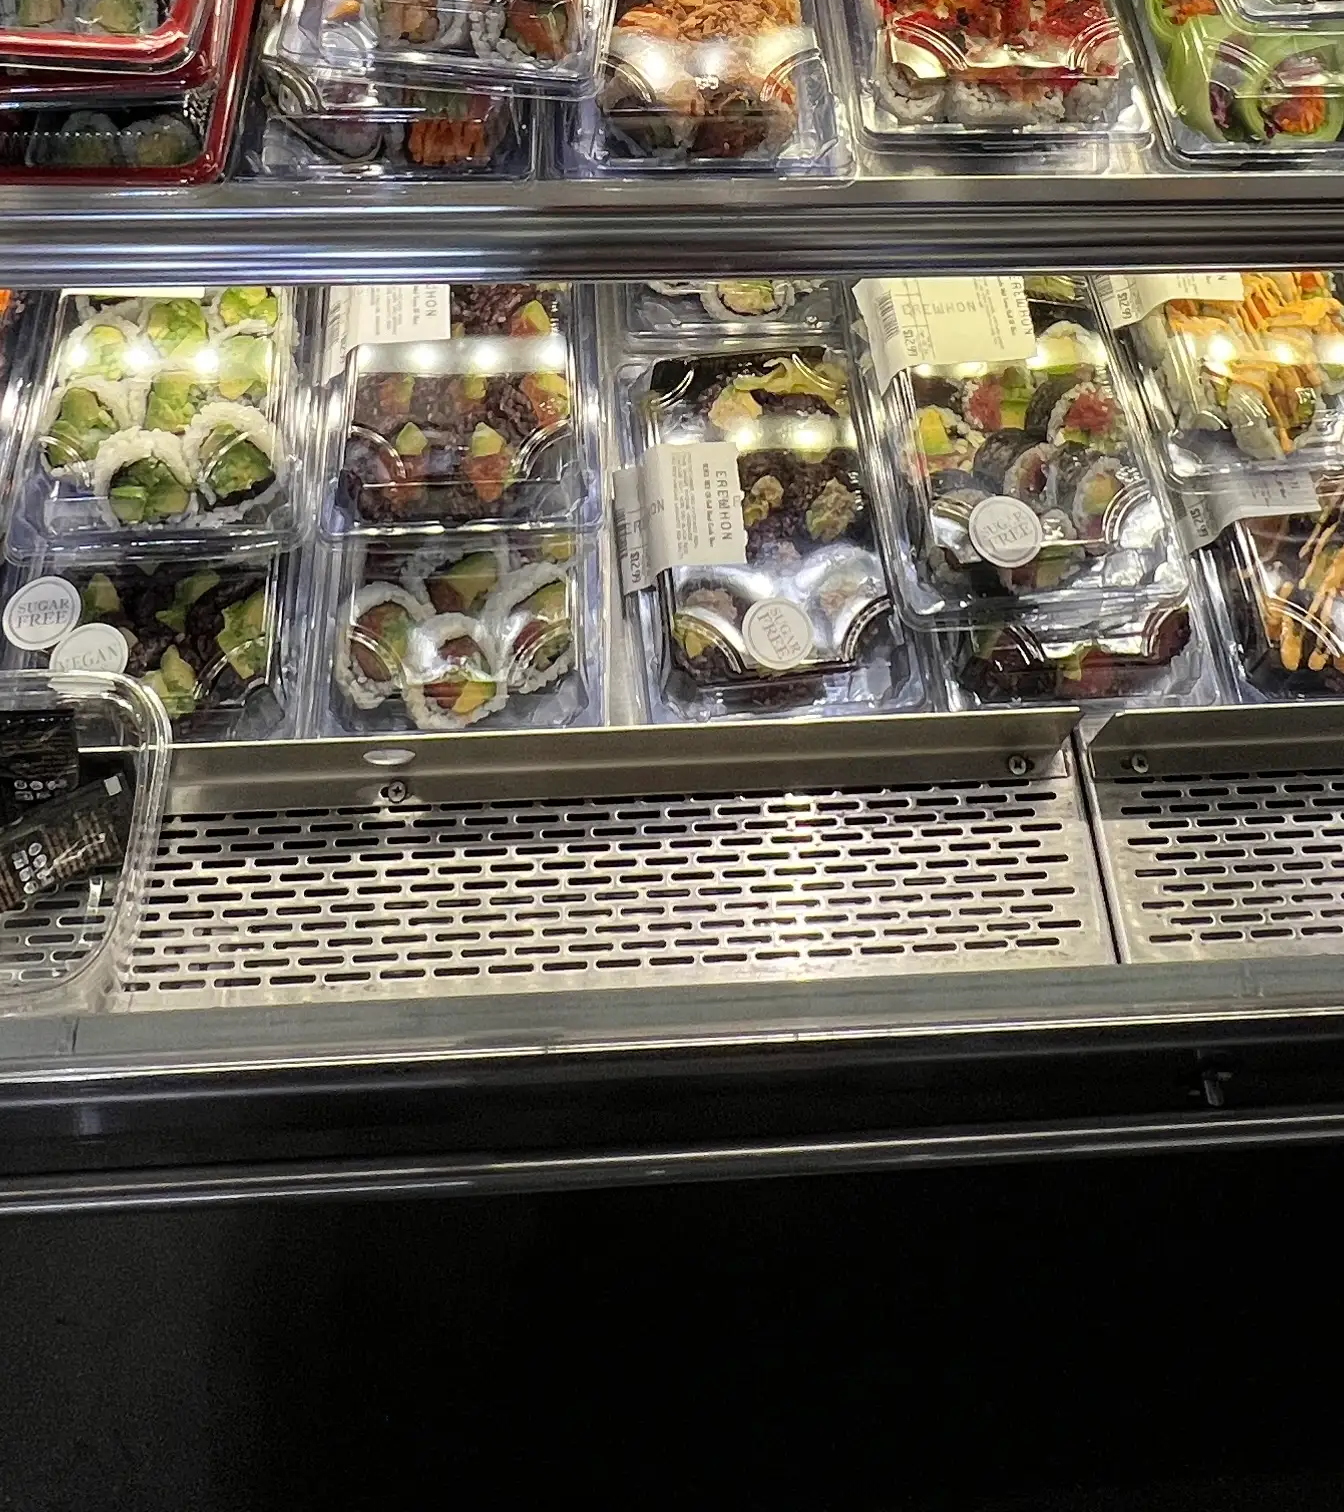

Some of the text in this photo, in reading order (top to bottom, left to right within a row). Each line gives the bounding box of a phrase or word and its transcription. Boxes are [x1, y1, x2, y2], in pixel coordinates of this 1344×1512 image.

[715, 470, 733, 541] EREWHON
[981, 509, 1024, 536] SUGAR
[988, 524, 1032, 551] FREE
[17, 598, 70, 614] SUGAR
[17, 610, 68, 629] FREE
[757, 612, 790, 661] FREE
[768, 607, 801, 655] SUGAR
[57, 642, 121, 670] VEGAN
